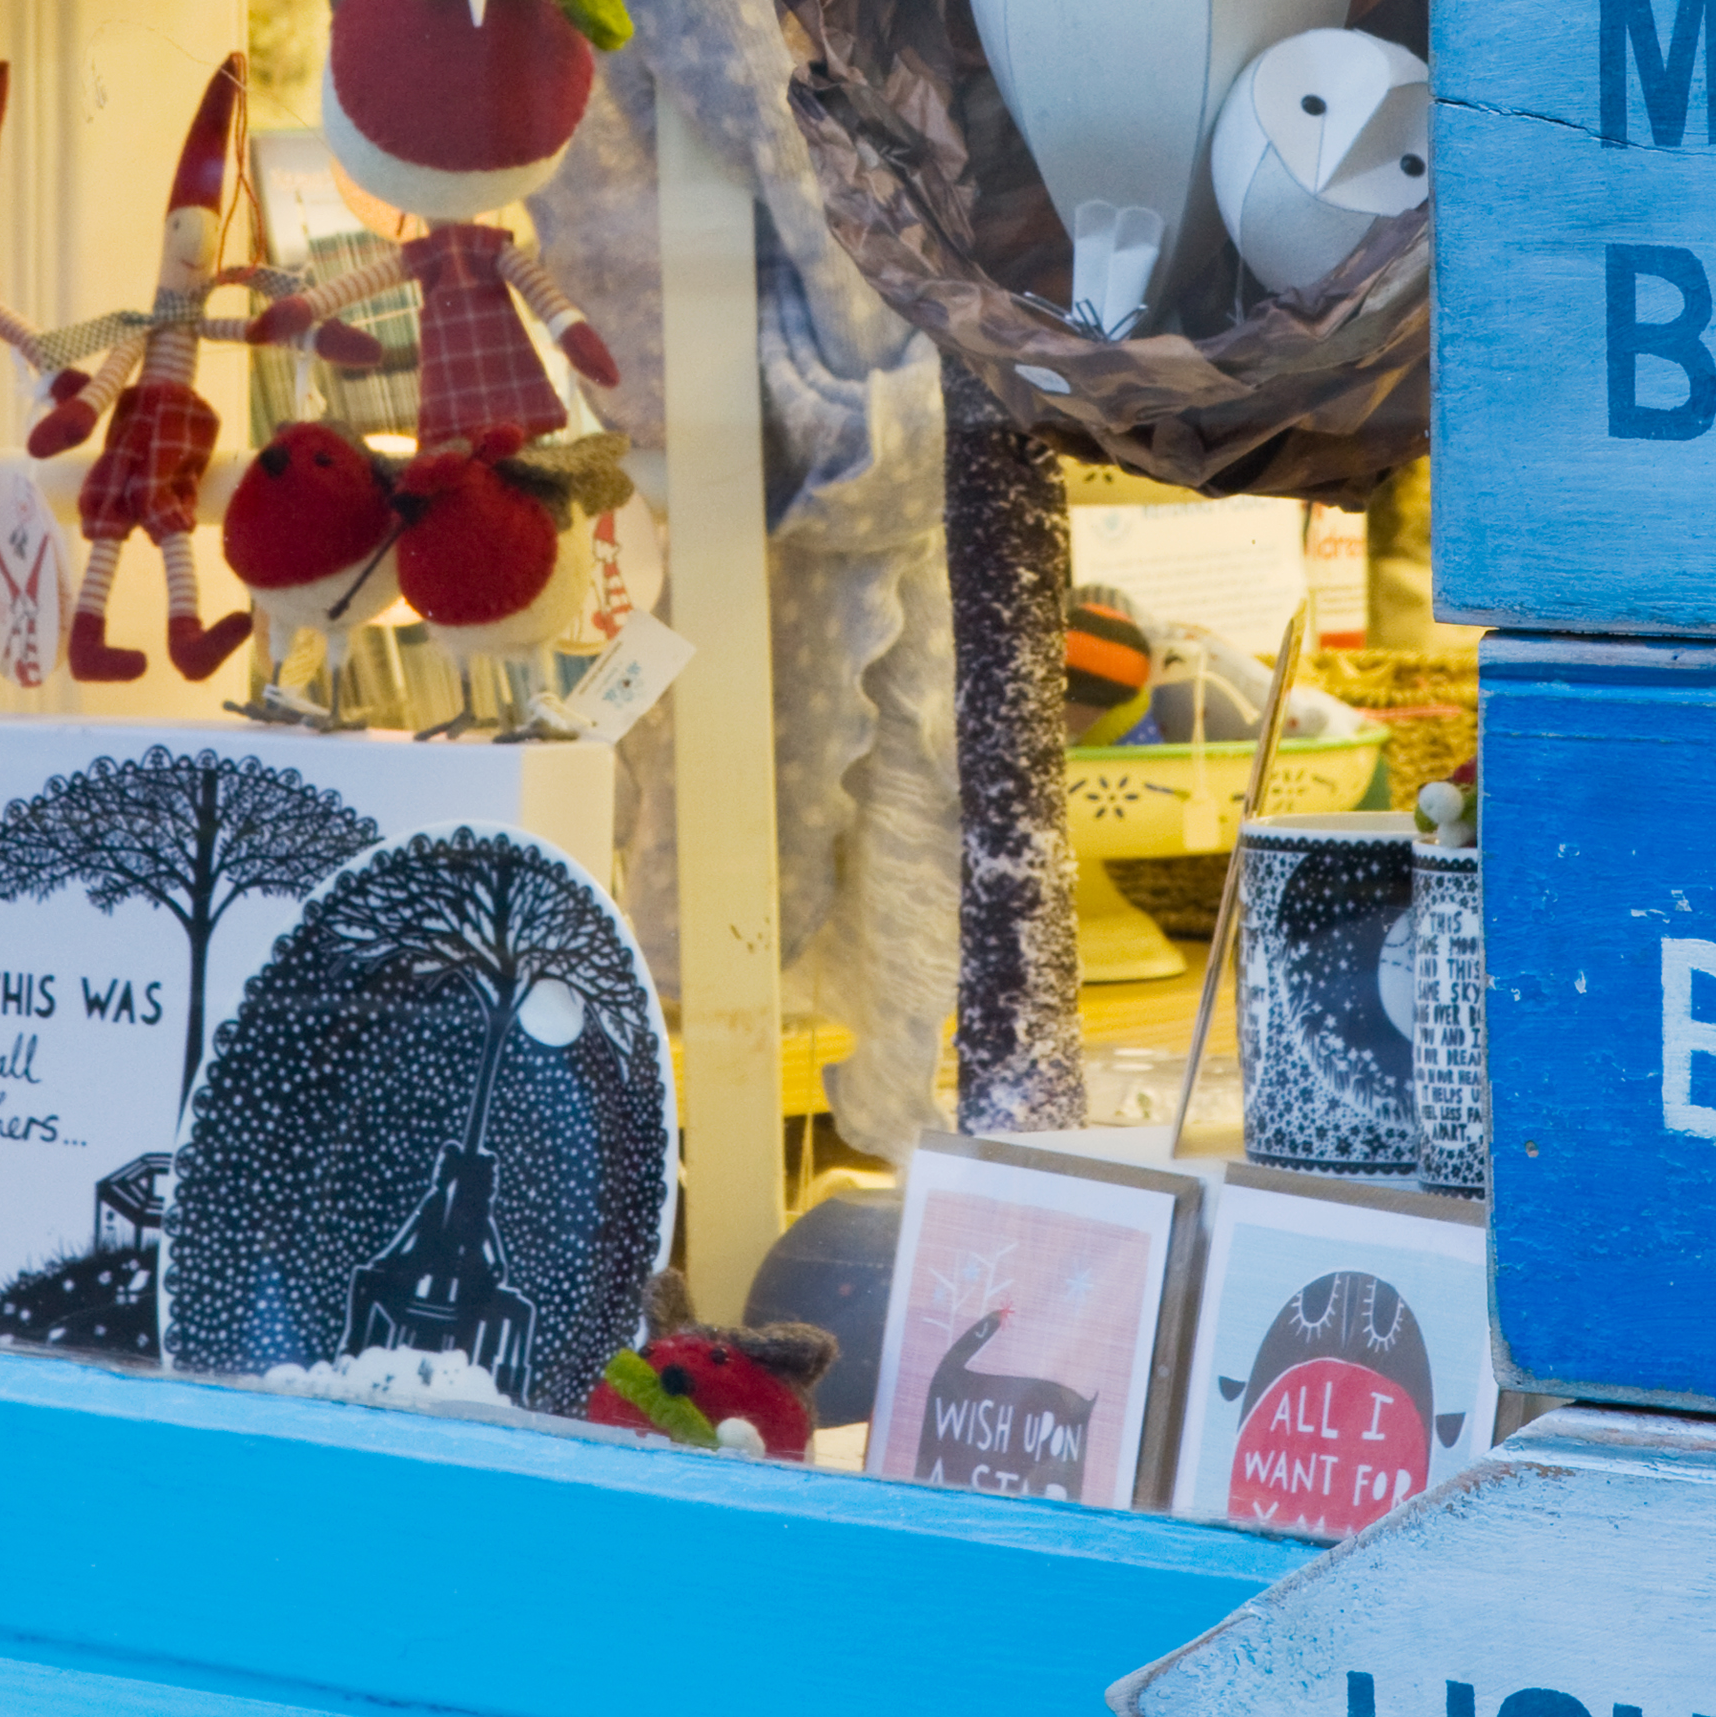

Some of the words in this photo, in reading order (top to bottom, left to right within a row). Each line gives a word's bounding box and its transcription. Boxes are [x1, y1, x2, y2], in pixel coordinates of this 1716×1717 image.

[82, 976, 163, 1025] WAS
[935, 1396, 1015, 1455] WISH
[1023, 1410, 1083, 1463] UPON
[1270, 1380, 1339, 1440] ALL
[1361, 1390, 1395, 1442] I
[1245, 1449, 1339, 1497] WANT
[1352, 1464, 1412, 1511] FOR
